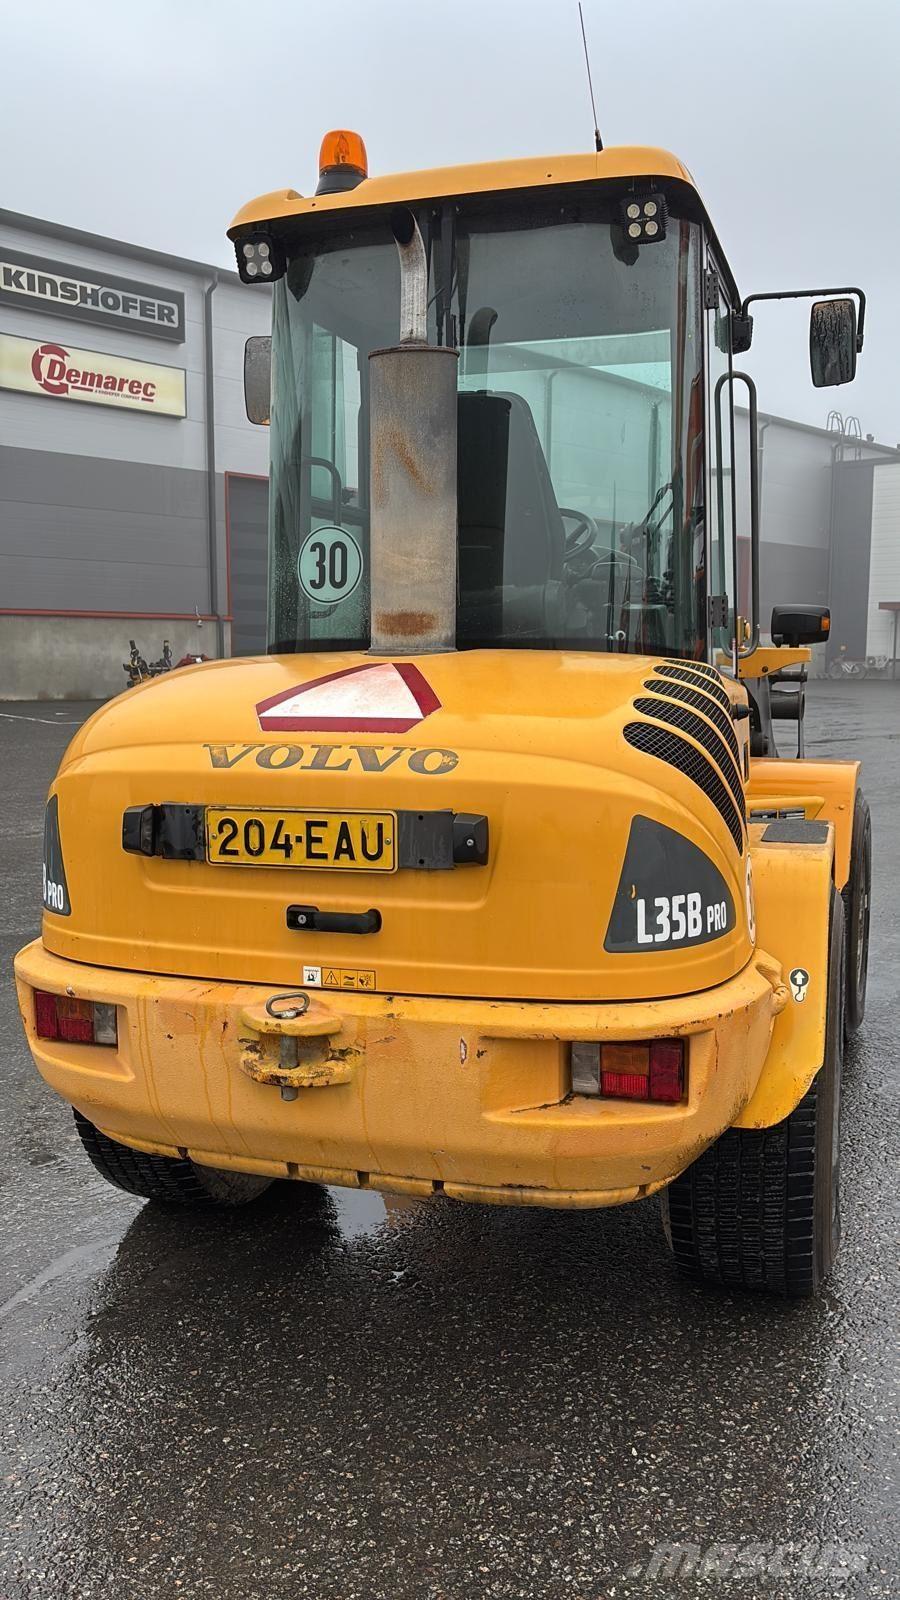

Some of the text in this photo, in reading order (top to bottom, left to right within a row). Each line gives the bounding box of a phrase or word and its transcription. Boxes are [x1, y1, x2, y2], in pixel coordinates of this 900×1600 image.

[3, 266, 176, 324] KINSHOFER
[46, 358, 157, 397] Demarec
[309, 541, 348, 590] 30
[202, 743, 460, 775] VOLVO
[47, 880, 64, 910] PRO
[636, 892, 702, 944] L35B
[706, 901, 727, 934] PRO
